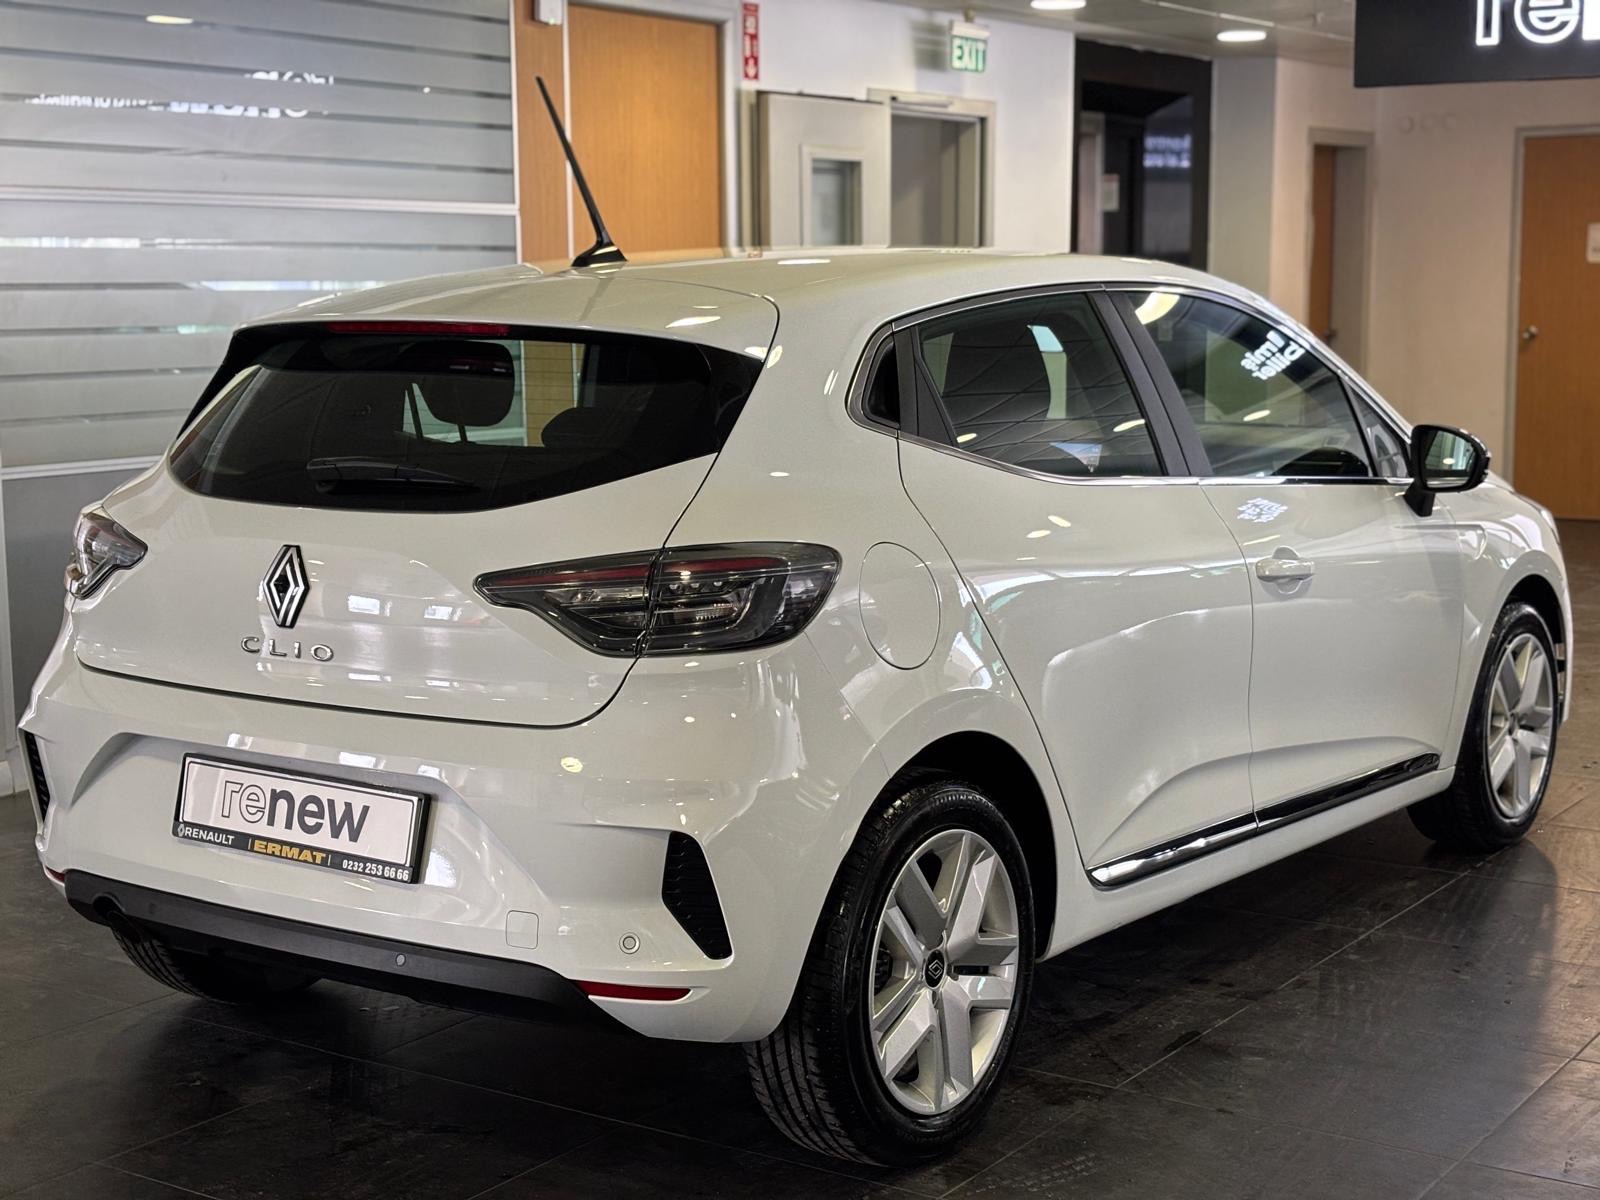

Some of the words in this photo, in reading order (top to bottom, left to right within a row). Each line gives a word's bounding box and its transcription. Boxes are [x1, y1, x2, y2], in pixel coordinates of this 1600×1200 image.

[952, 37, 987, 71] EXIT
[240, 635, 335, 662] CLIO
[221, 779, 371, 843] renew
[184, 826, 235, 847] RENAULT
[253, 839, 326, 864] ERMAT
[342, 858, 364, 873] 0232
[365, 862, 383, 876] 253
